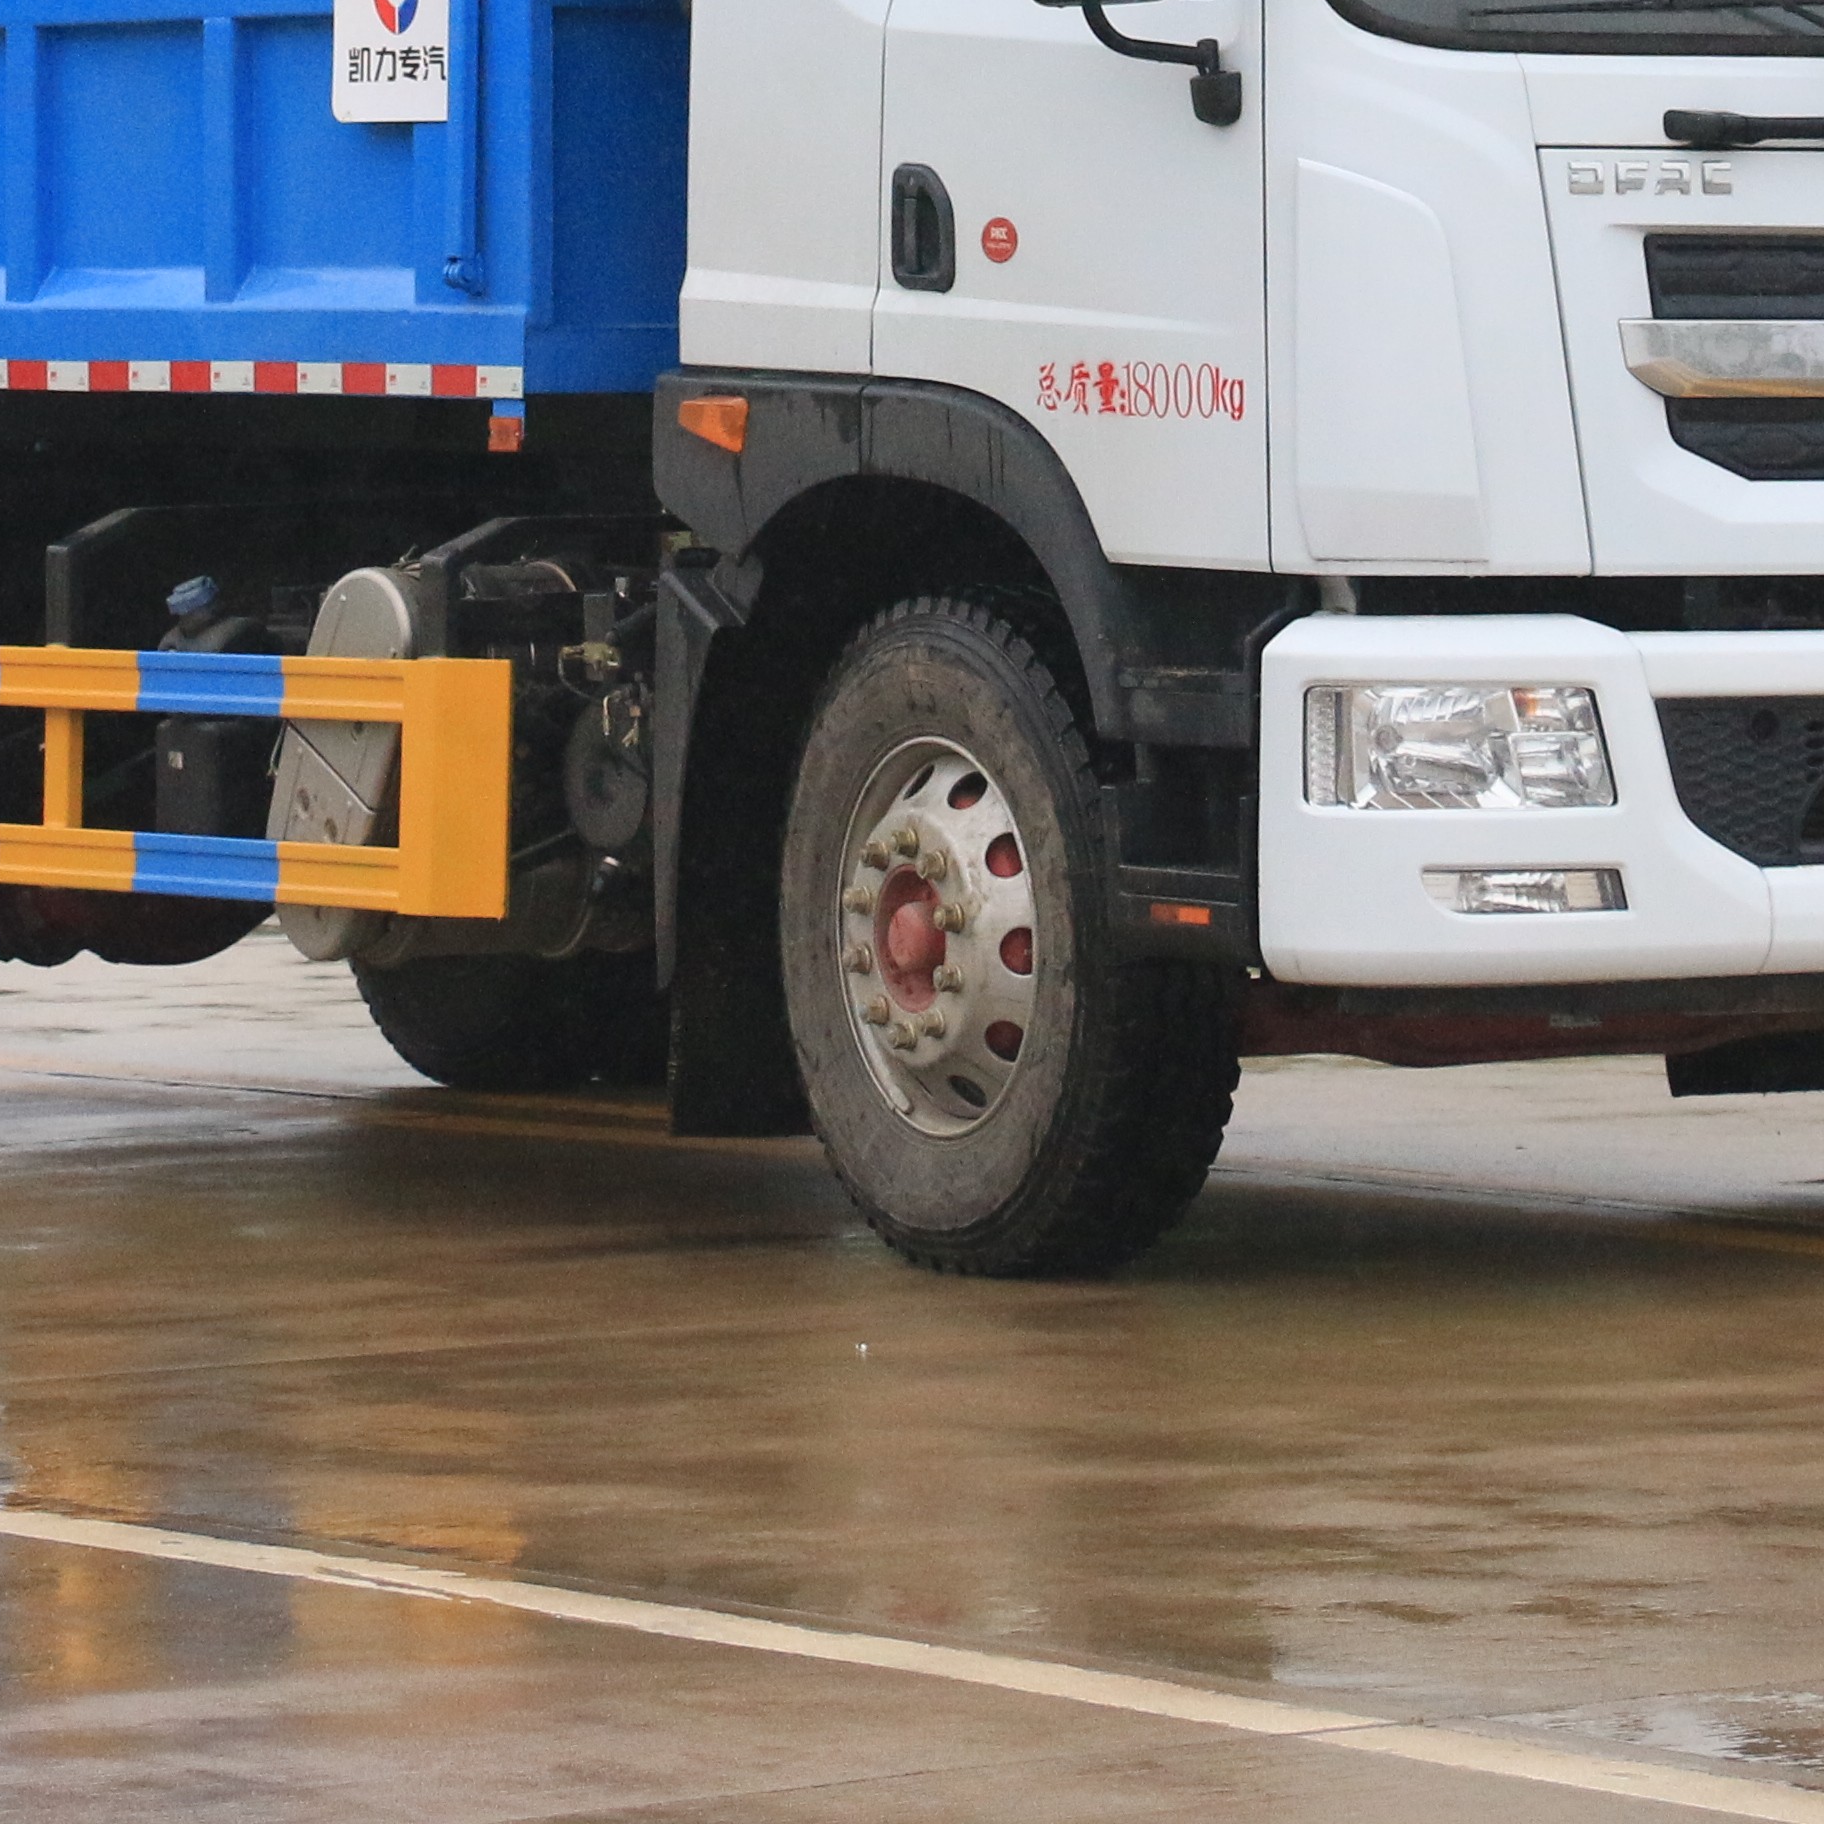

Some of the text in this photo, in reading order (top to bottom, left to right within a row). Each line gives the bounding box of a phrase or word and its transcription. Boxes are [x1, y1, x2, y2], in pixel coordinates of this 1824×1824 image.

[348, 46, 447, 83] 凯力专汽
[1568, 160, 1733, 196] DFAC
